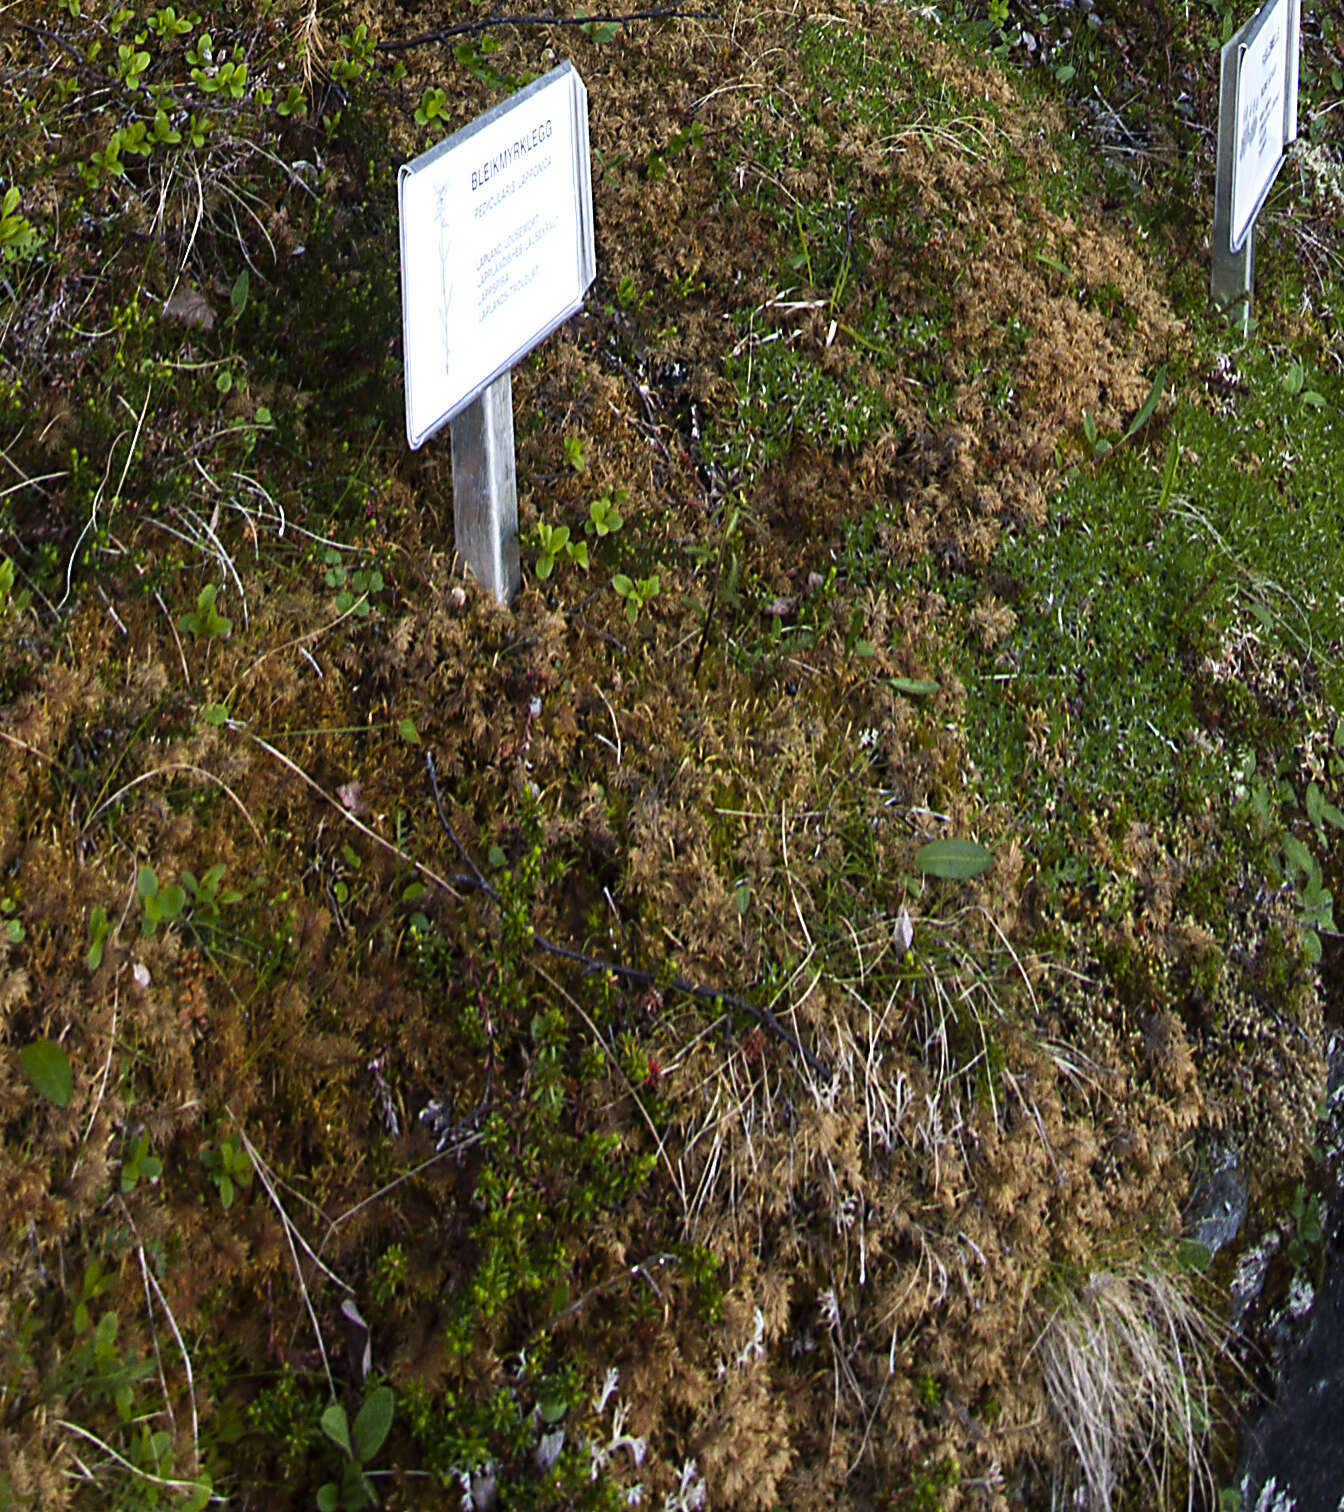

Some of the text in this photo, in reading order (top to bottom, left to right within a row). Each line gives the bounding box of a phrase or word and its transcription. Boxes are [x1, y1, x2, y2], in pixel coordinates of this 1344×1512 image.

[471, 119, 553, 192] BLEIKMYRKLEGG
[474, 154, 552, 221] PEDICULARIS LAPPONICA
